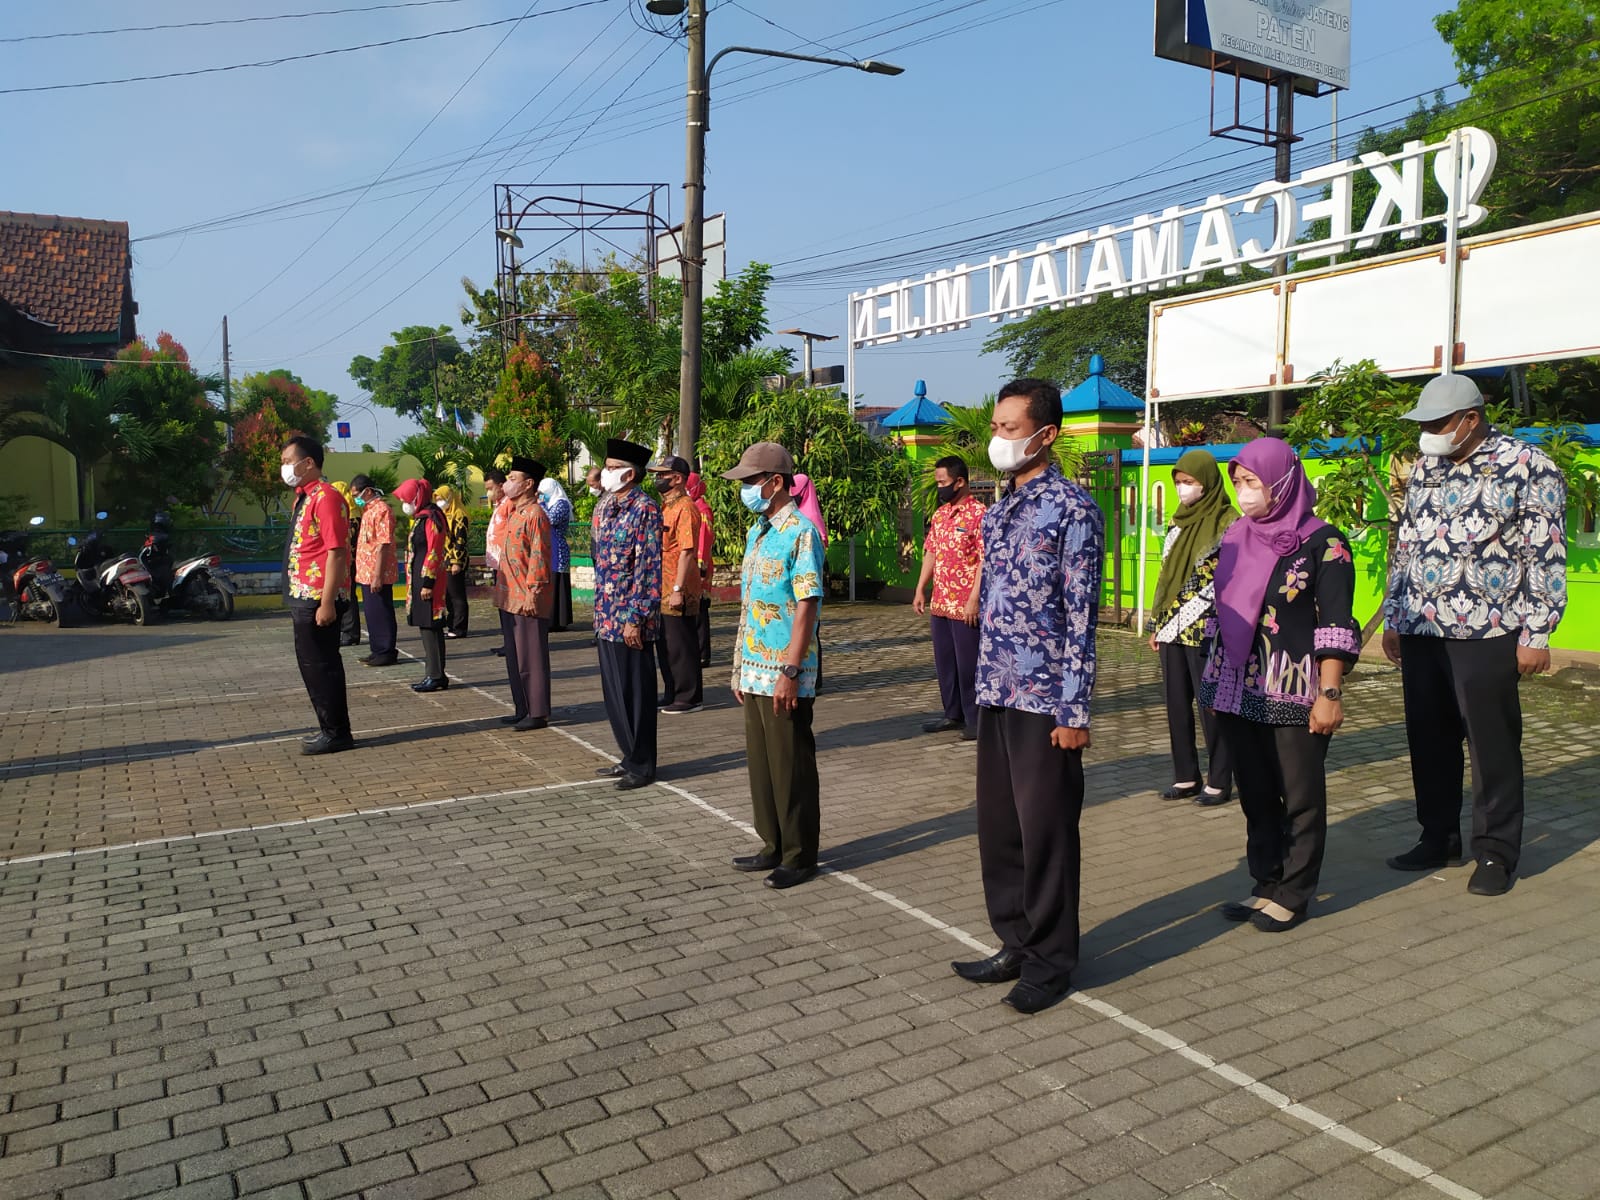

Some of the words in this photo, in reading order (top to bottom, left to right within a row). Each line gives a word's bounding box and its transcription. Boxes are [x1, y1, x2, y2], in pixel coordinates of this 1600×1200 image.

[1256, 12, 1315, 54] PATEN
[1307, 4, 1349, 32] JATENG
[1220, 33, 1263, 57] KECAMATAN
[1264, 46, 1286, 64] MIJEN
[1286, 53, 1323, 74] KABUPATEN
